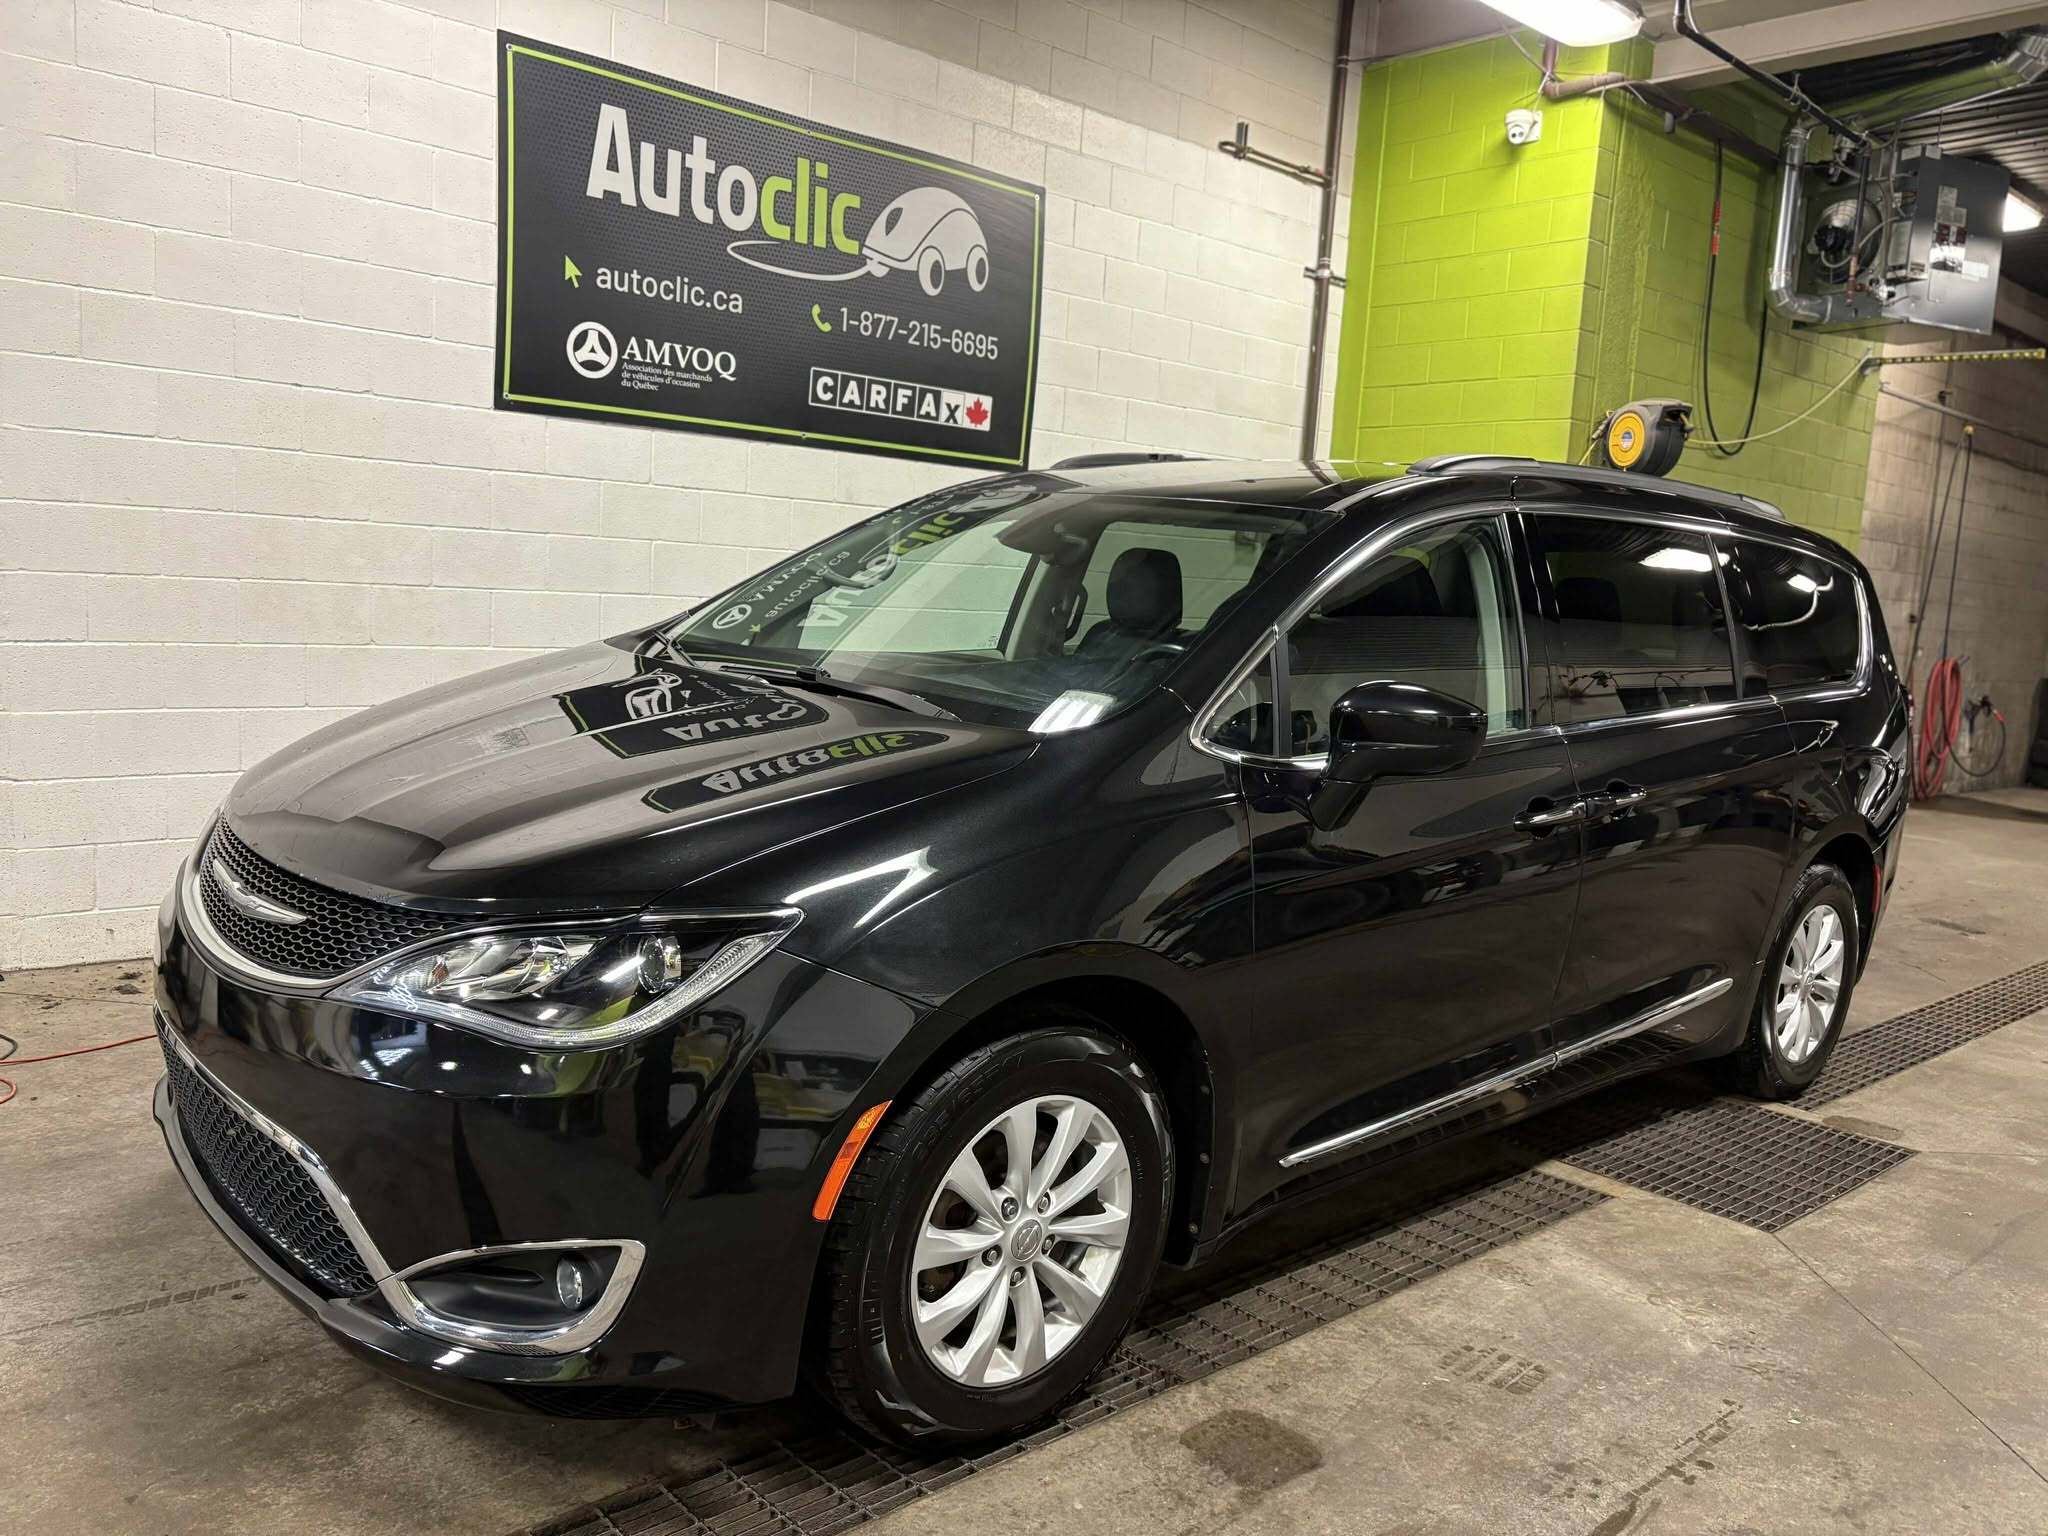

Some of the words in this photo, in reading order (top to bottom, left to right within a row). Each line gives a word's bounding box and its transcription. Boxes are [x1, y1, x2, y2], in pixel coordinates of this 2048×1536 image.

[586, 102, 861, 256] Autoclic
[596, 266, 744, 314] autoclic.ca
[840, 307, 999, 360] 1-877-215-6695
[621, 336, 737, 382] AMVOQ
[621, 371, 631, 379] de
[632, 372, 664, 383] véhicules
[622, 362, 662, 375] Association
[662, 367, 675, 377] des
[676, 370, 713, 383] marchands
[621, 379, 631, 388] du
[632, 380, 660, 392] Québec
[816, 376, 961, 425] CARFAX
